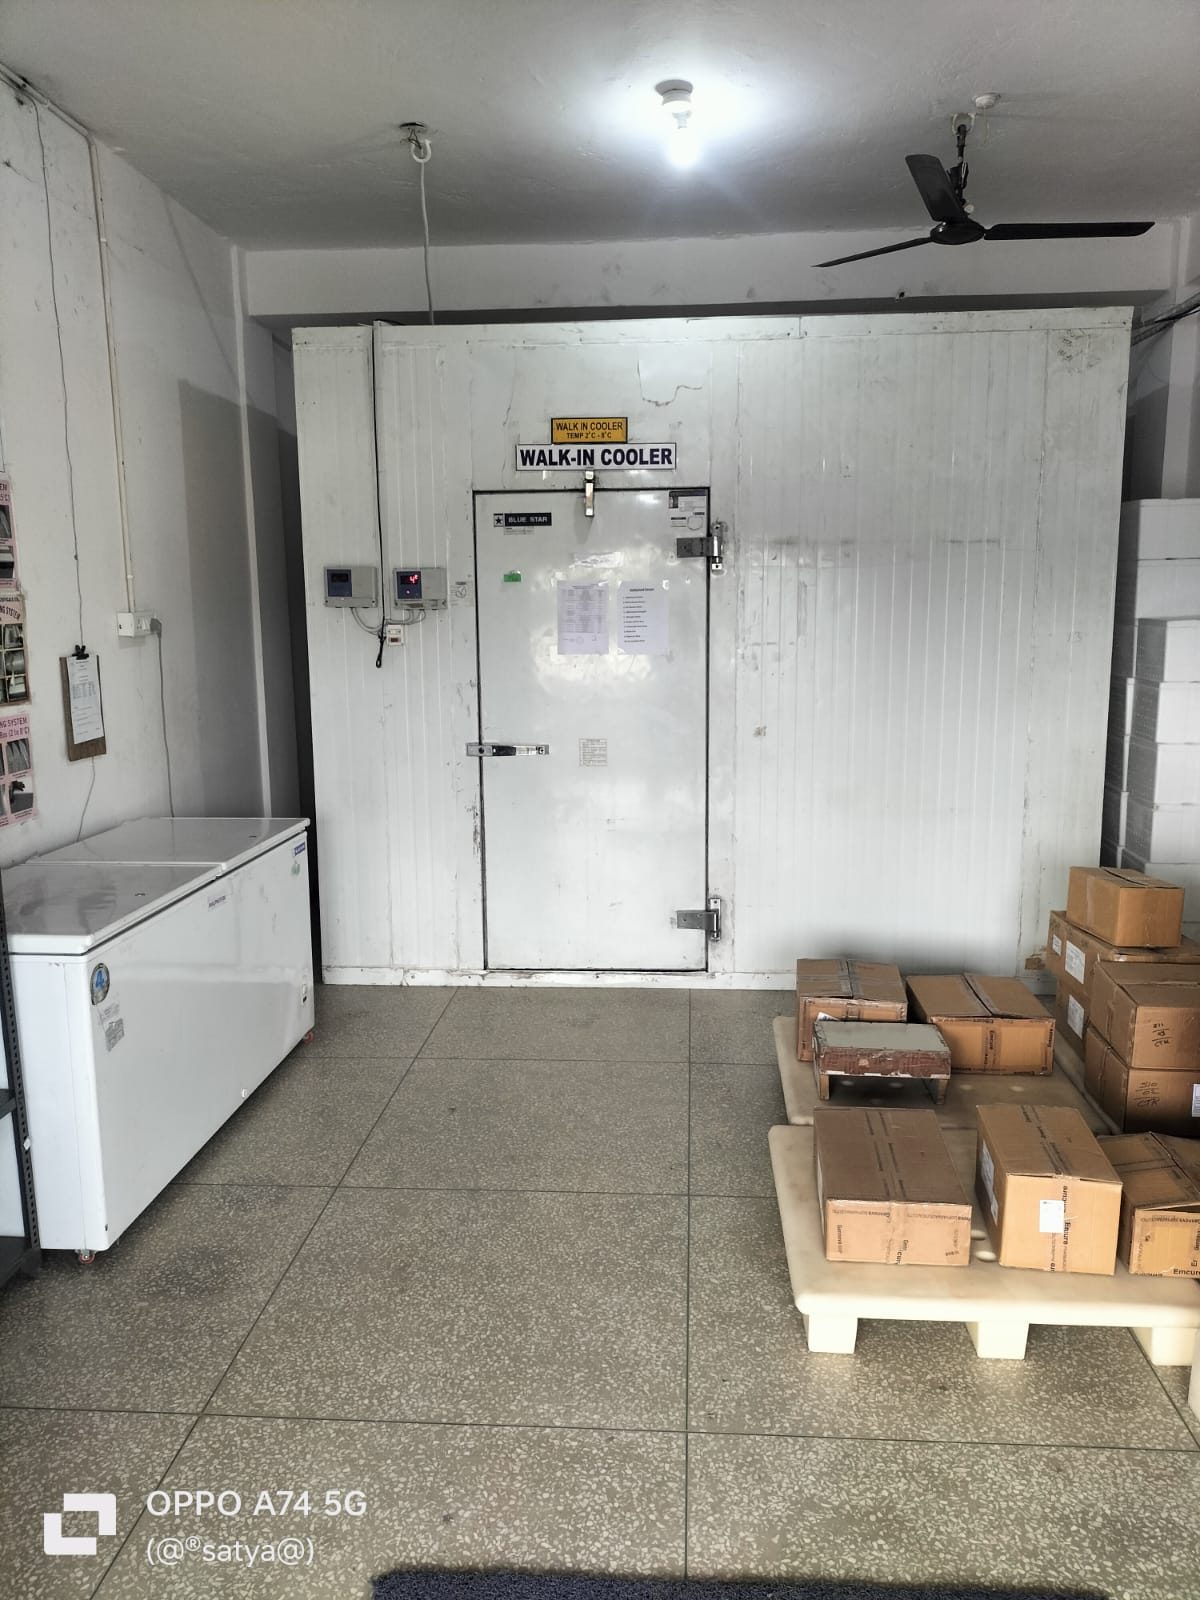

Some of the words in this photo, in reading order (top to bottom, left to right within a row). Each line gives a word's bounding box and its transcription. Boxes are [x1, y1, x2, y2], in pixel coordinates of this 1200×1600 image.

[556, 422, 579, 431] WALK
[580, 422, 588, 430] IN
[590, 421, 623, 431] COOLER
[520, 449, 595, 466] WALK-IN
[600, 448, 673, 466] COOLER
[7, 717, 27, 727] SYSTEM
[1173, 1268, 1200, 1276] Emcur
